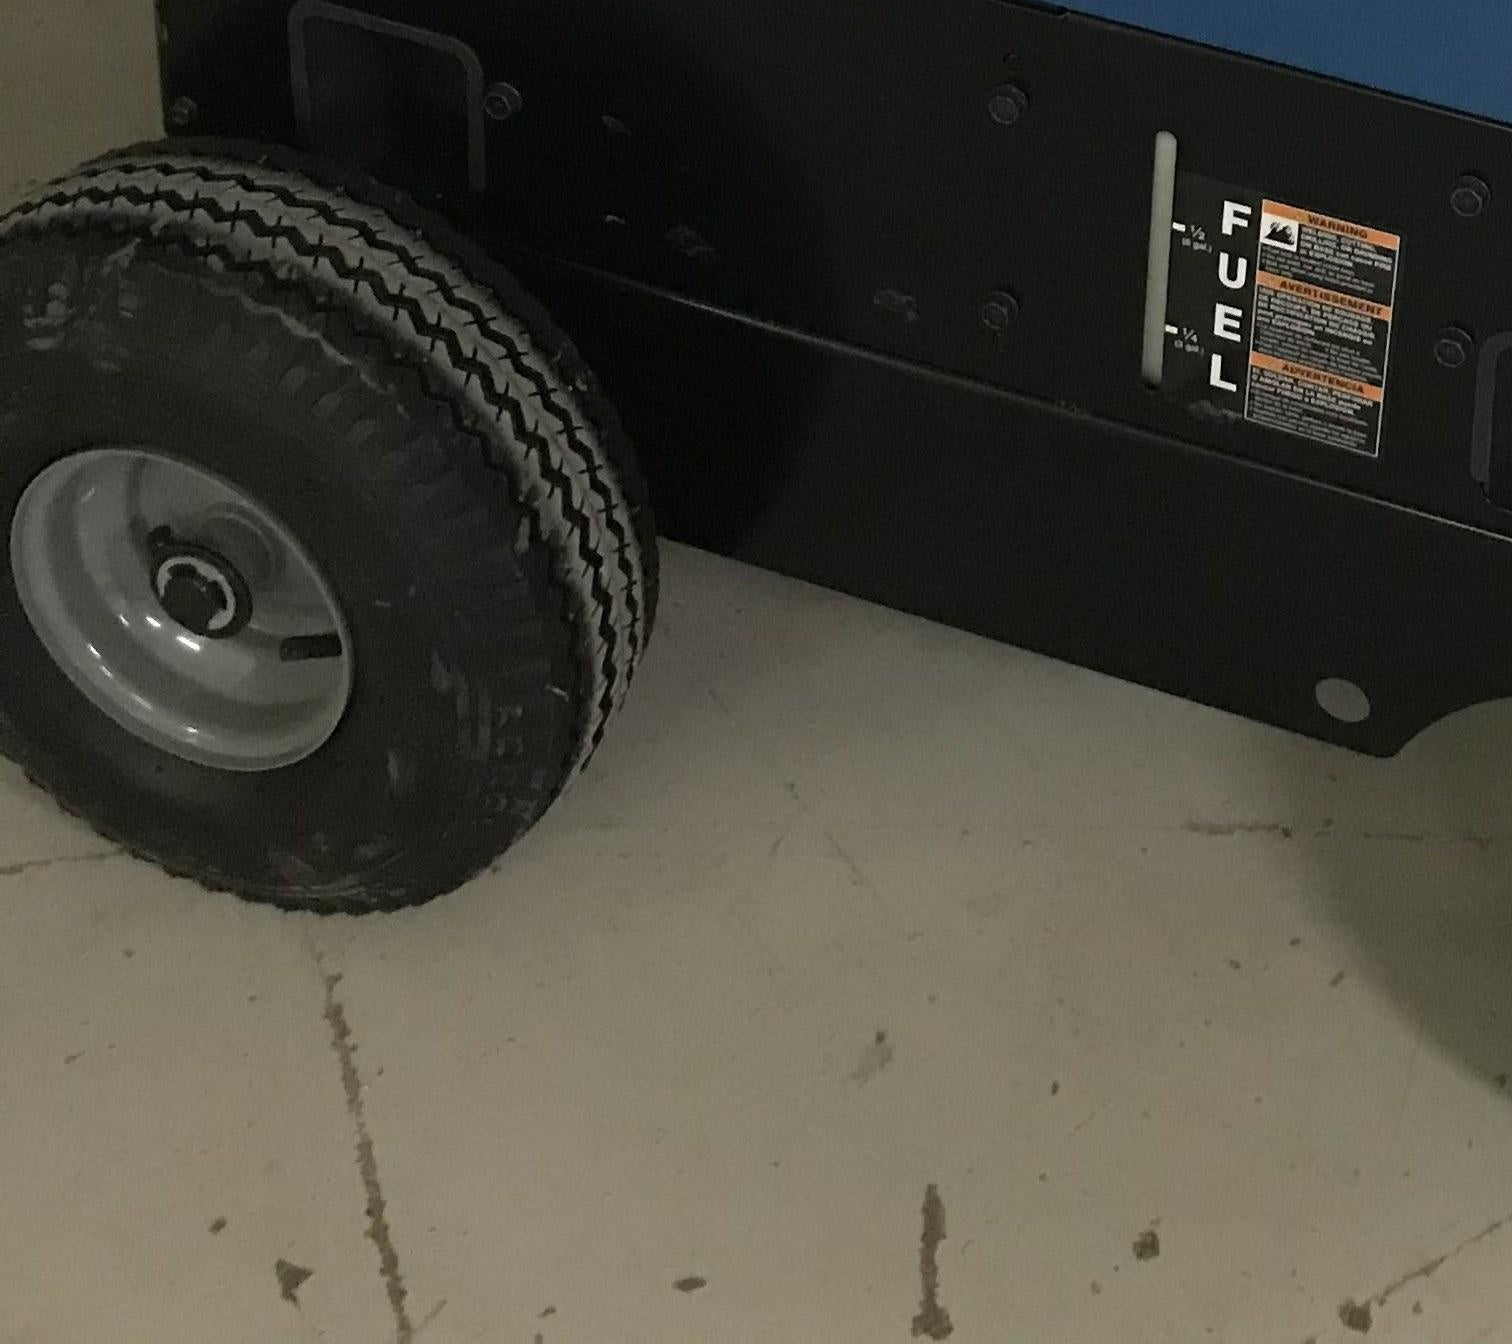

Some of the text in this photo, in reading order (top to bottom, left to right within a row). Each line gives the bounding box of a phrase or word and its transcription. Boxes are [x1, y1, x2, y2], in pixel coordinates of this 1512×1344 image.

[1307, 213, 1369, 240] WARNING
[1210, 199, 1252, 393] FUEL
[1279, 280, 1384, 316] AVERTISSEMENT
[1282, 362, 1365, 395] ADVERTENCIA
